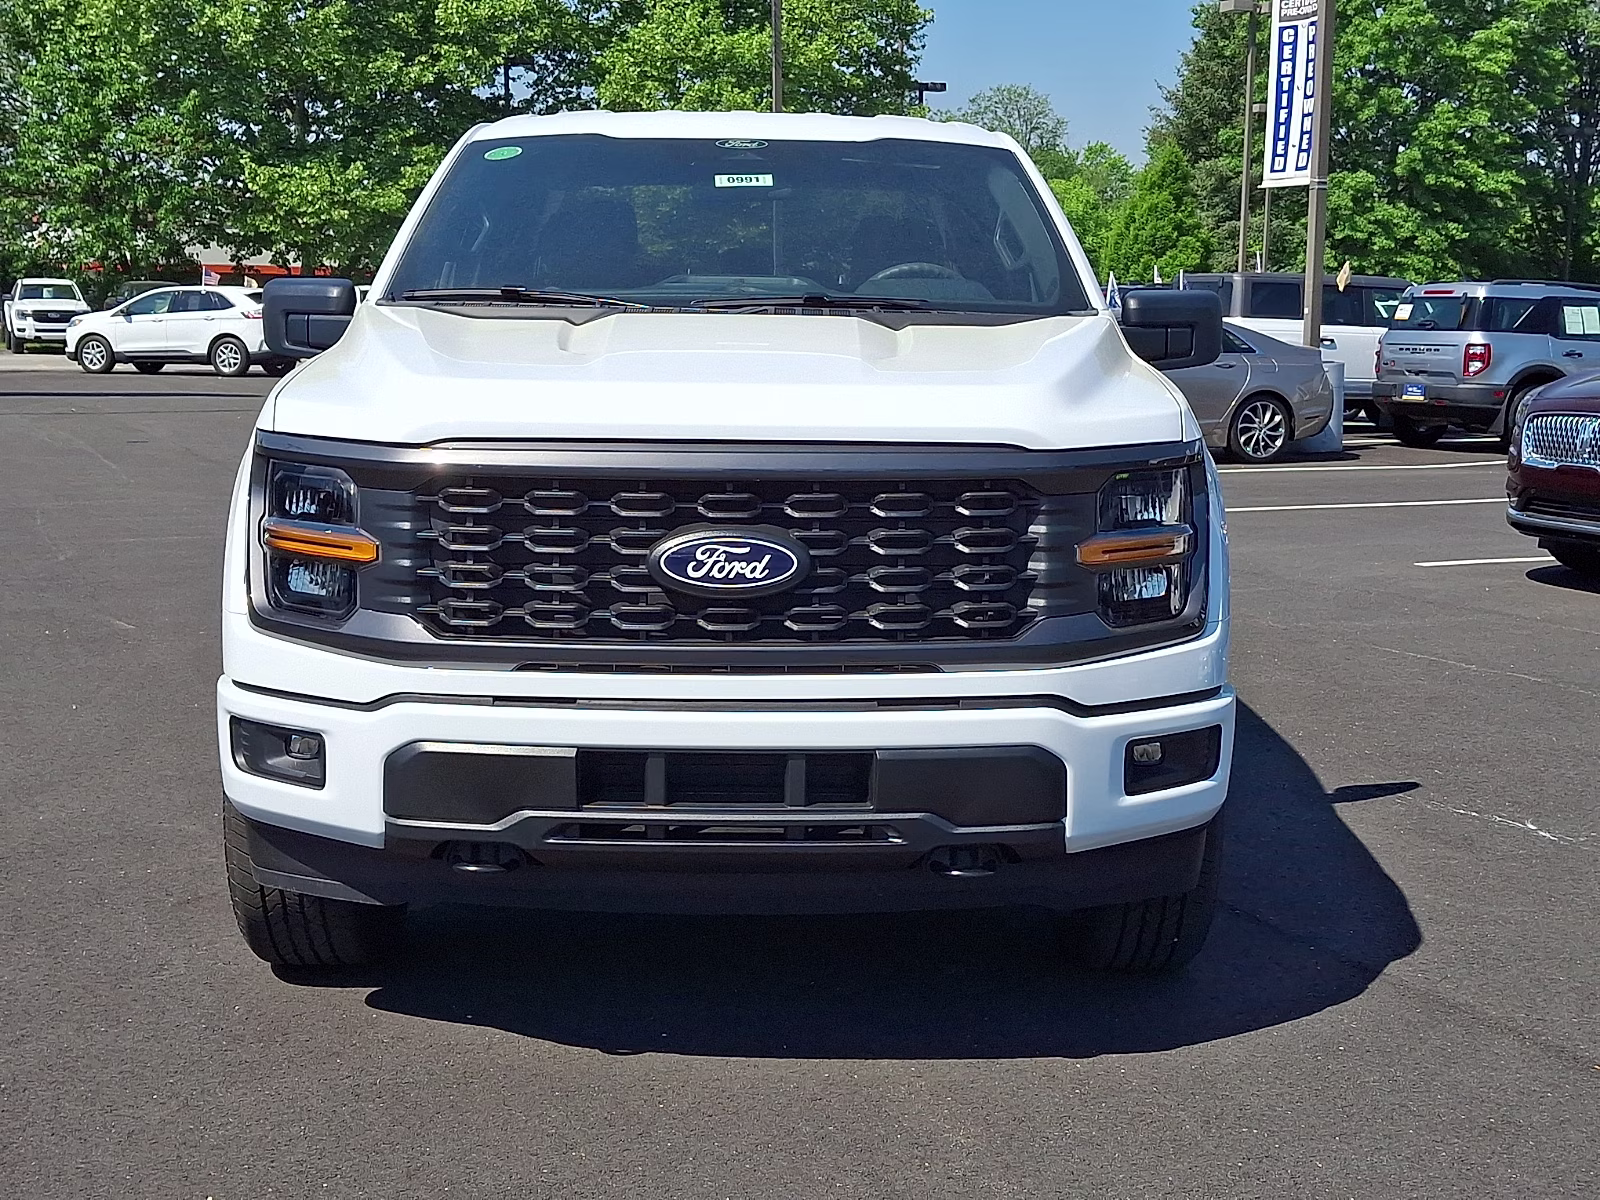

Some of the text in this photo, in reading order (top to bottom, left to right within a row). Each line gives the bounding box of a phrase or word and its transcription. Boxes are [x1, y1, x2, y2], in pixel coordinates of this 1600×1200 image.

[1273, 28, 1295, 171] CERTIFIED
[724, 139, 760, 148] Ford
[727, 176, 760, 184] 0991
[686, 544, 772, 579] Ford
